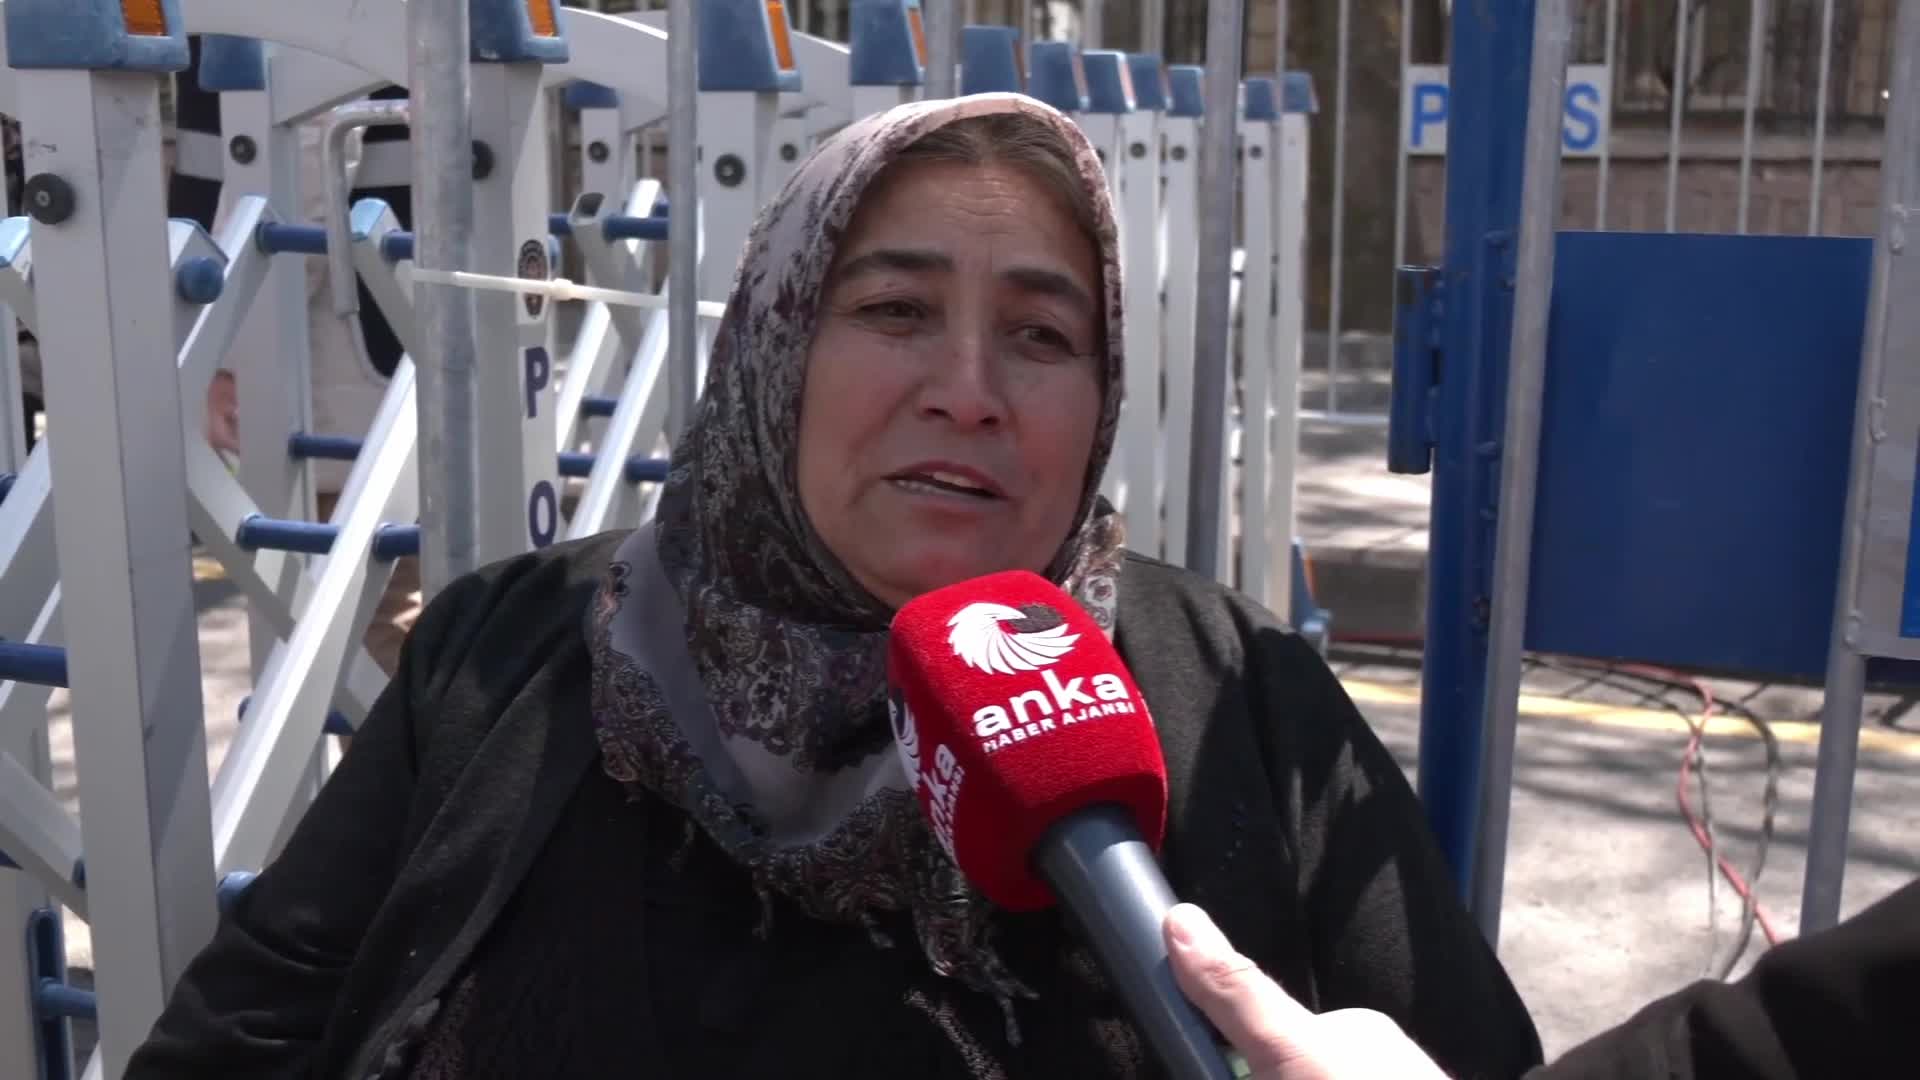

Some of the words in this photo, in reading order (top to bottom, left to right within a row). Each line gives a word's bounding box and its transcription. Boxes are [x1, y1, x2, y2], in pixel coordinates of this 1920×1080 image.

[972, 669, 1130, 738] anka
[982, 718, 1057, 753] HABER
[1062, 702, 1137, 726] AJANSI
